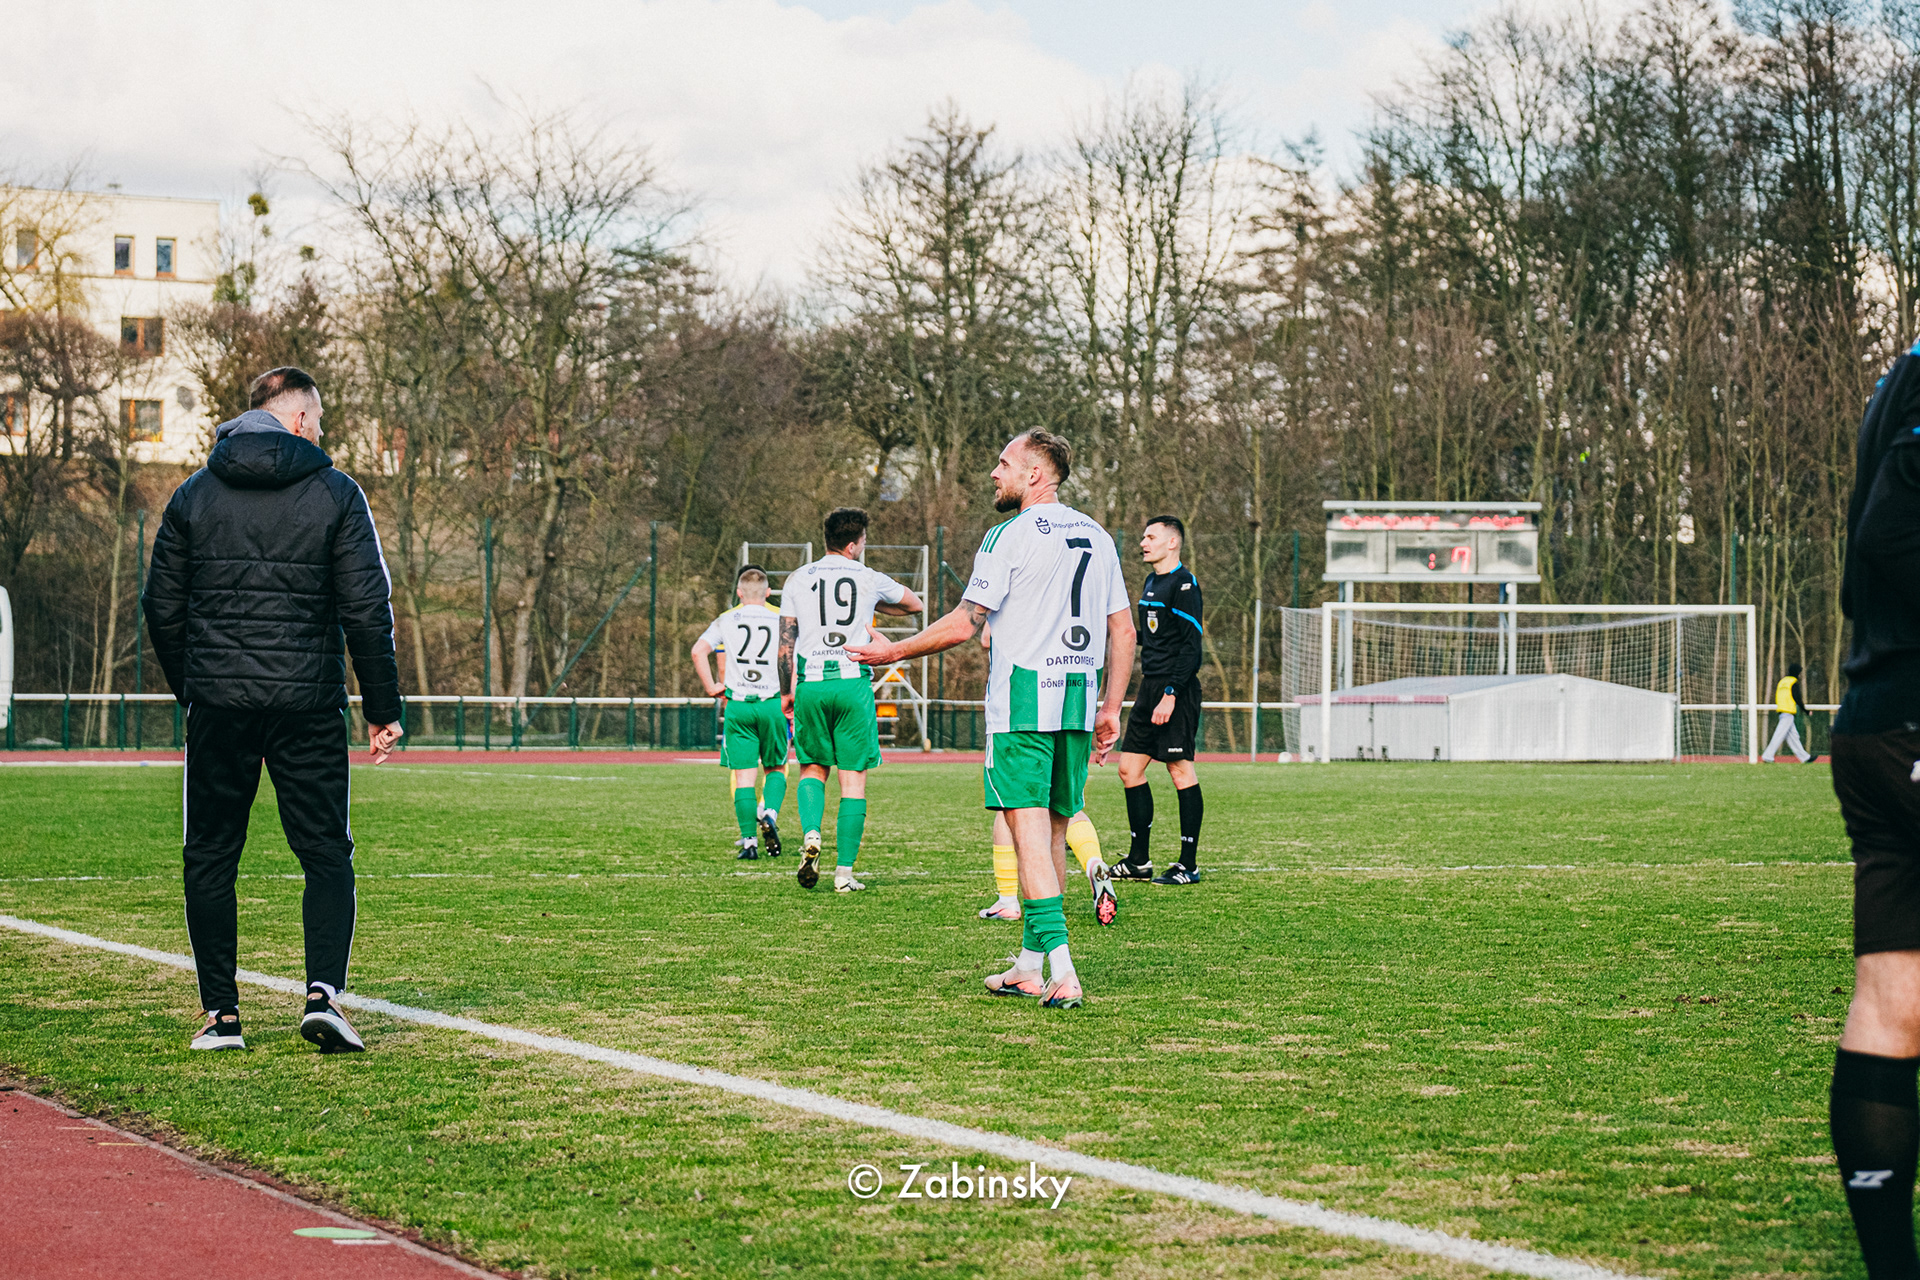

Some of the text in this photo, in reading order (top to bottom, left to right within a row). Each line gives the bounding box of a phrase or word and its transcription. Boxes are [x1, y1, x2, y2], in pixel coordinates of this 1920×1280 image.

[811, 577, 857, 627] 19
[1065, 537, 1092, 617] 7
[736, 623, 771, 665] 22
